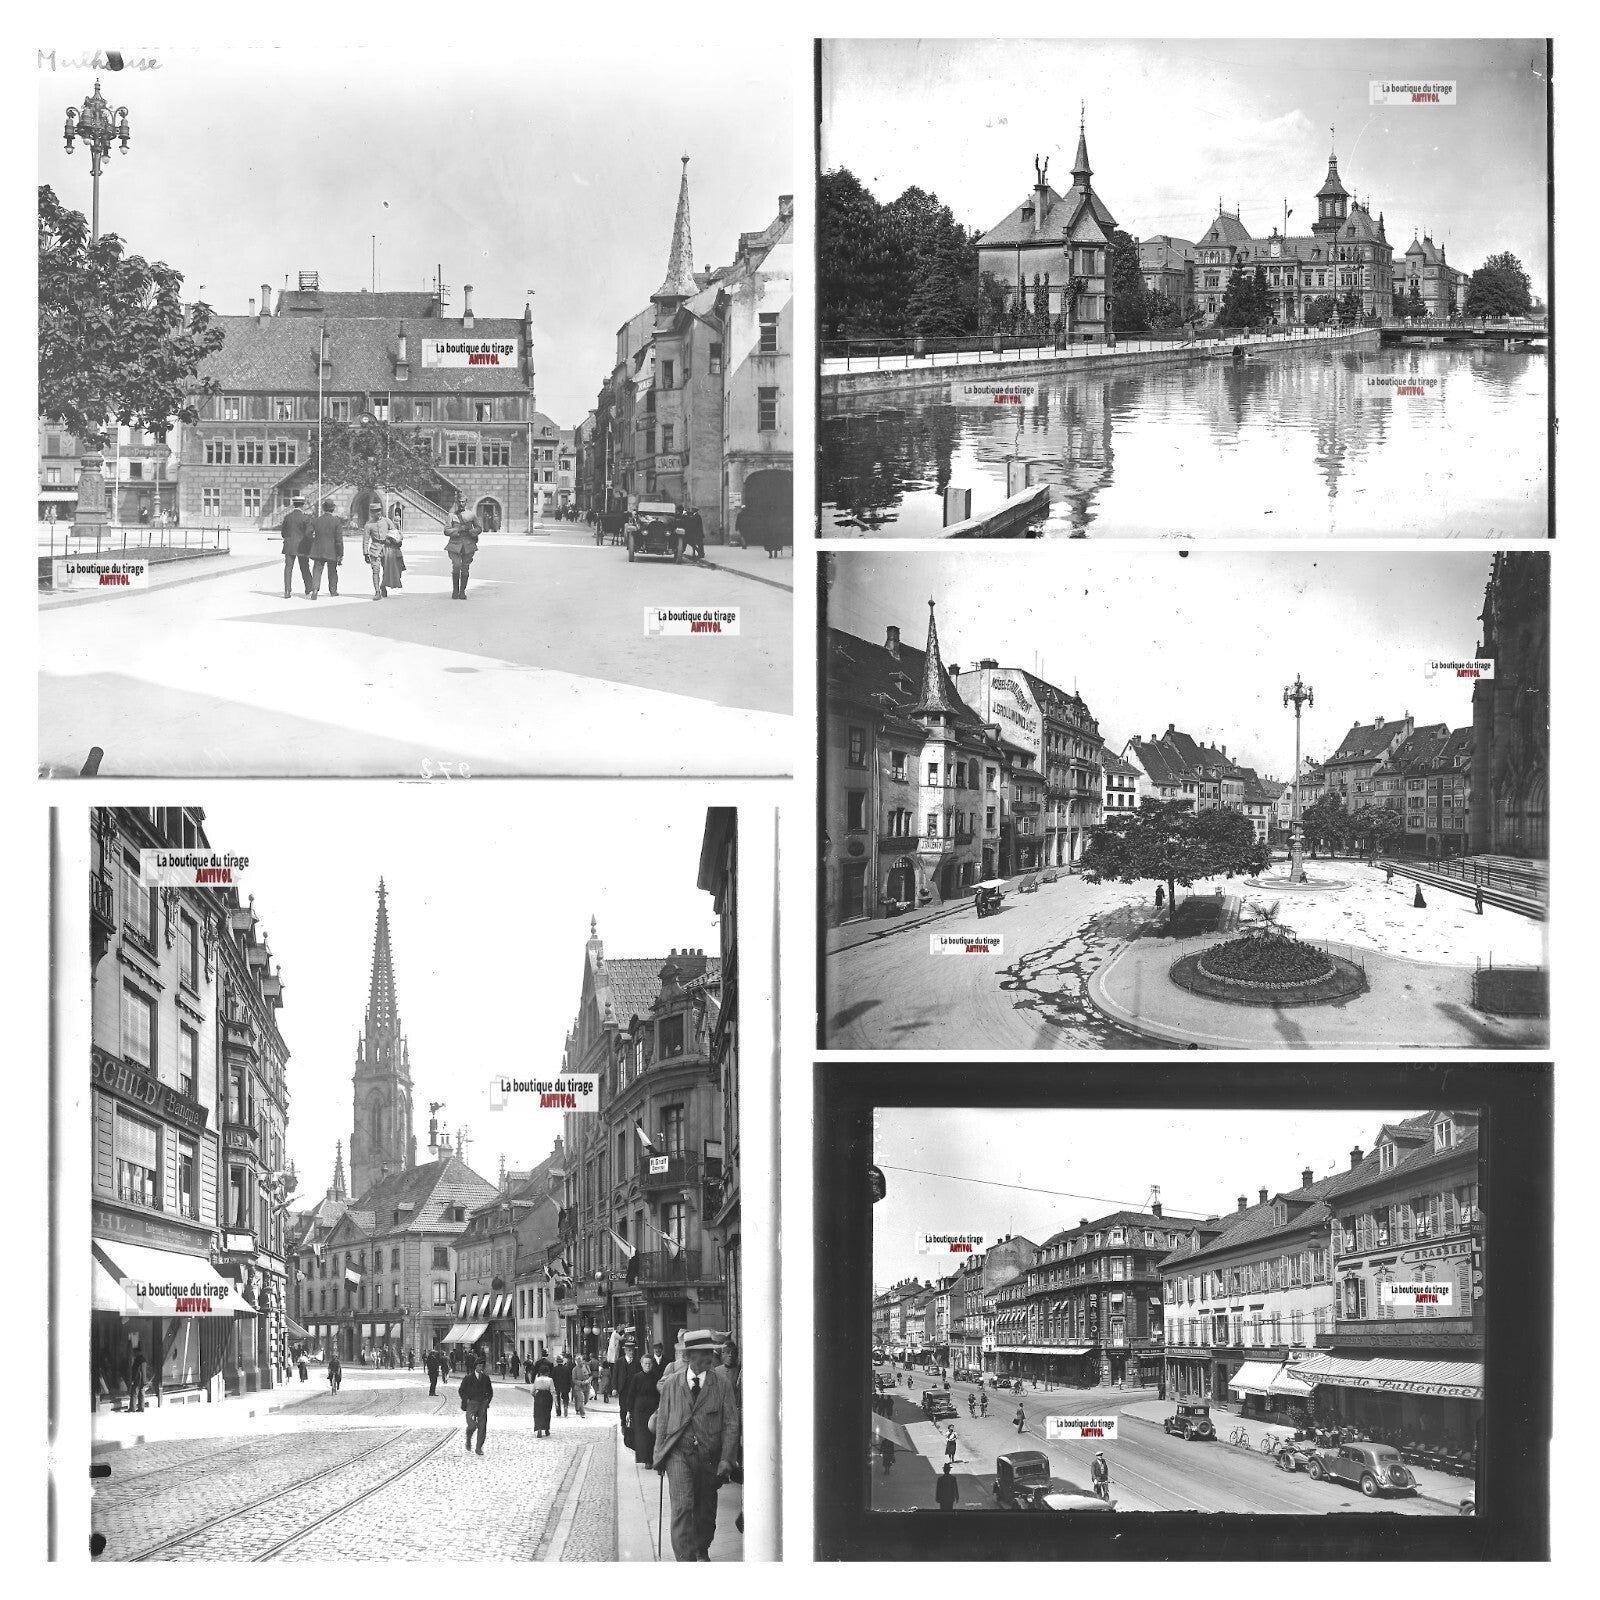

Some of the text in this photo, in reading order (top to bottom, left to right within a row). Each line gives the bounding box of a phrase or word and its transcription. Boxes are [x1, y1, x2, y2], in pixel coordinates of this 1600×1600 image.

[92, 1212, 126, 1232] HL
[1471, 1238, 1484, 1300] LIPP
[1089, 1293, 1098, 1338] BRISTOL
